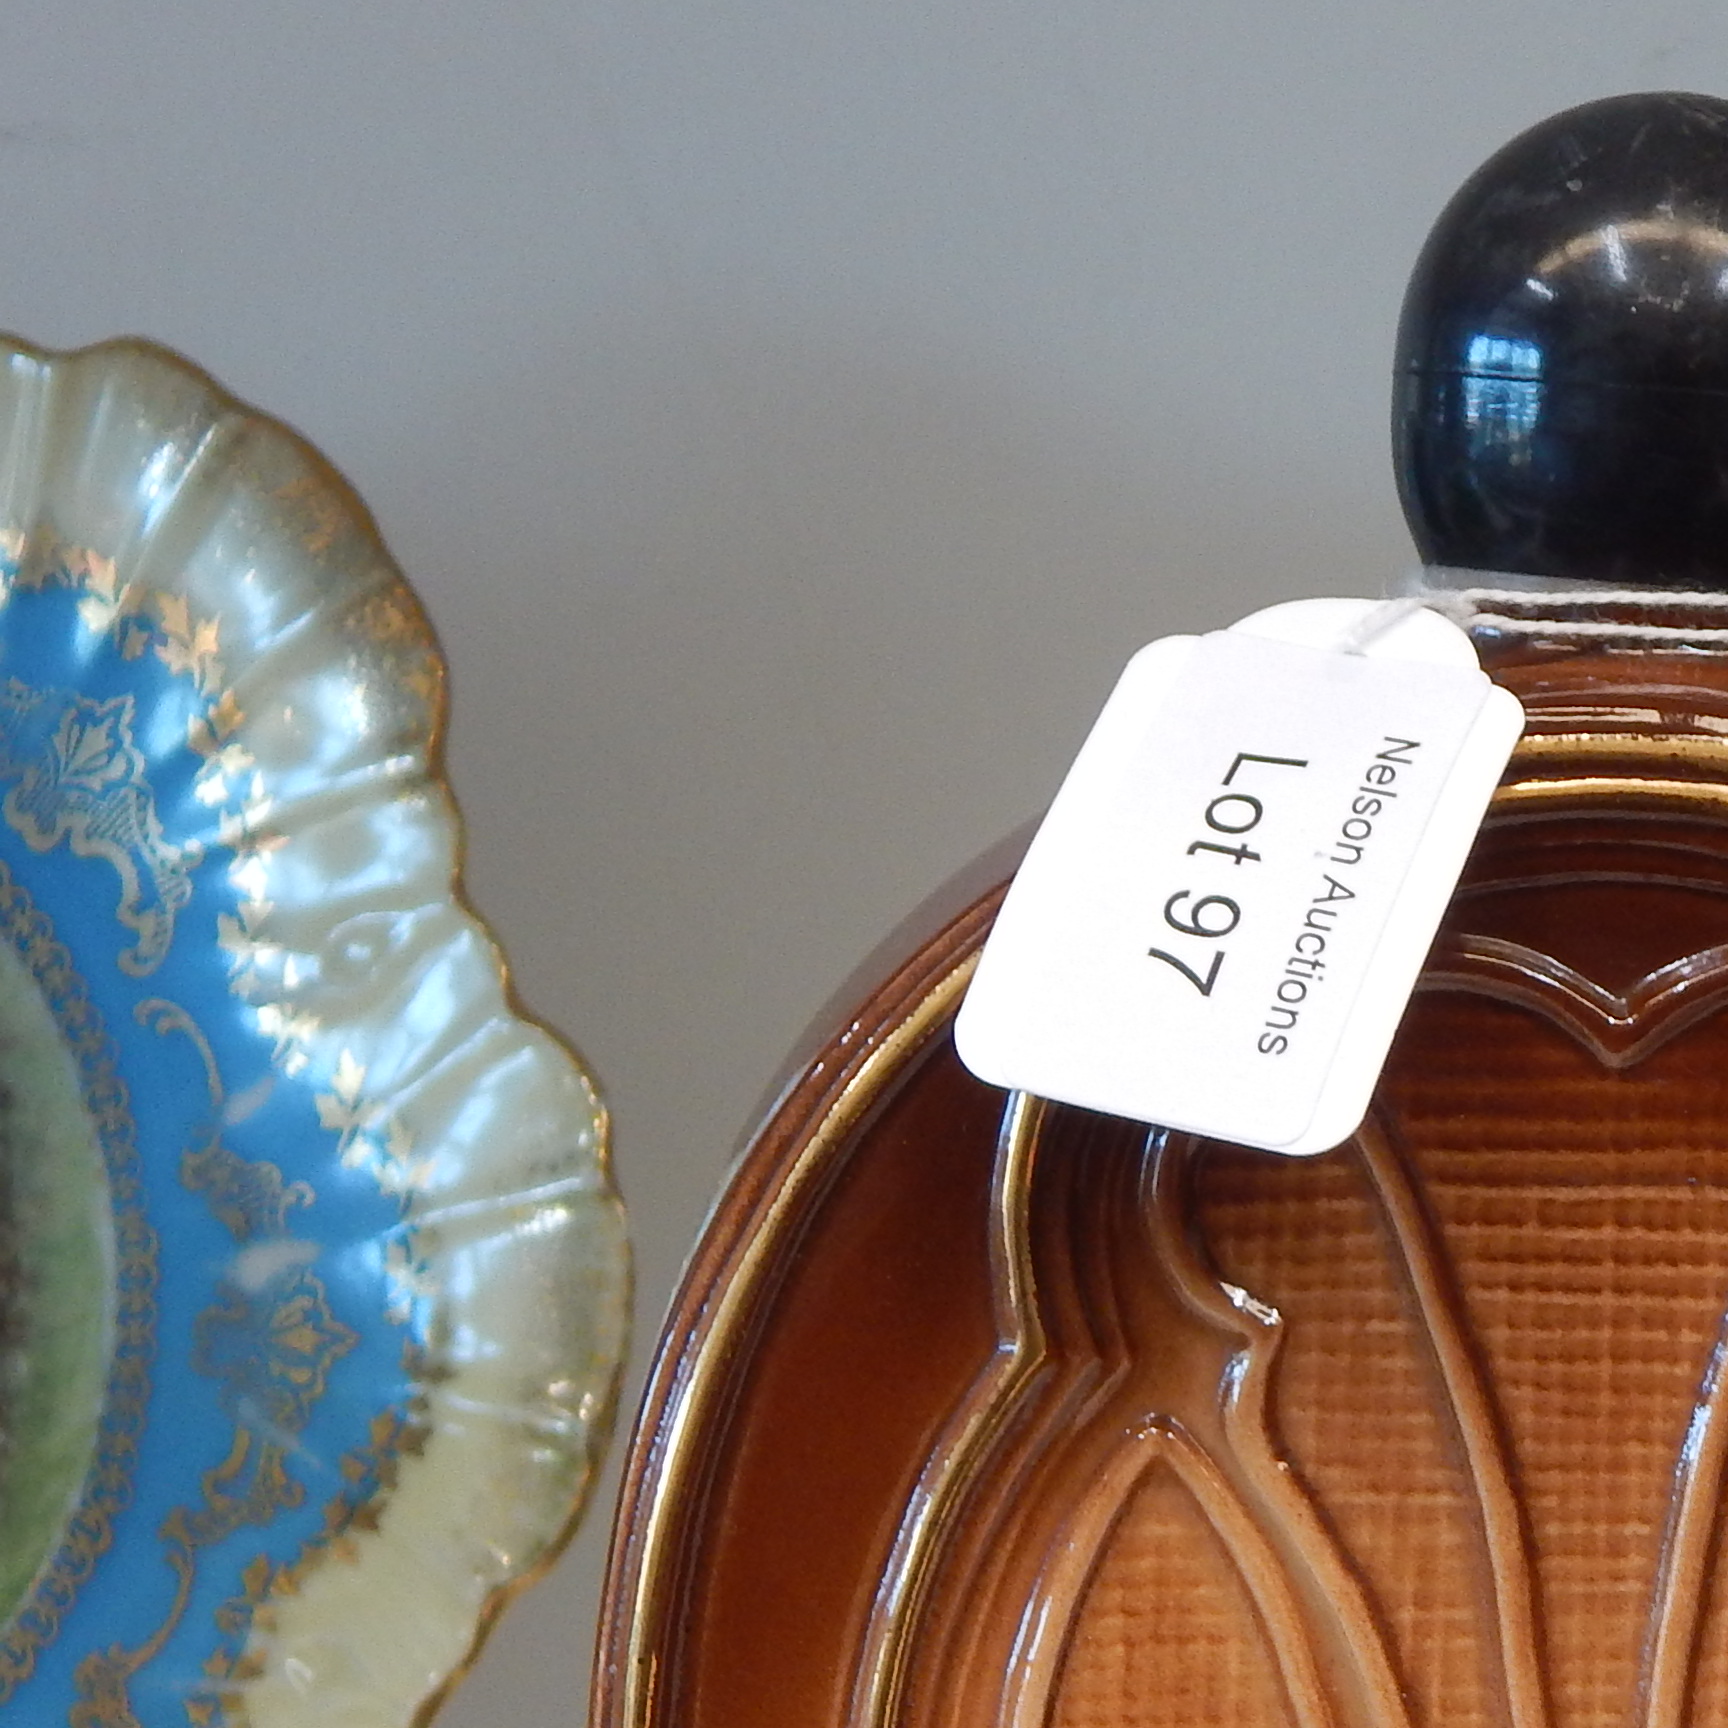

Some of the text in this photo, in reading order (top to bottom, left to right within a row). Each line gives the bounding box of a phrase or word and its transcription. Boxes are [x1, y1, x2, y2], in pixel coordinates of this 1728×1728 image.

[1147, 751, 1310, 998] Lot 97
[1256, 735, 1422, 1057] Nelson Auctions
